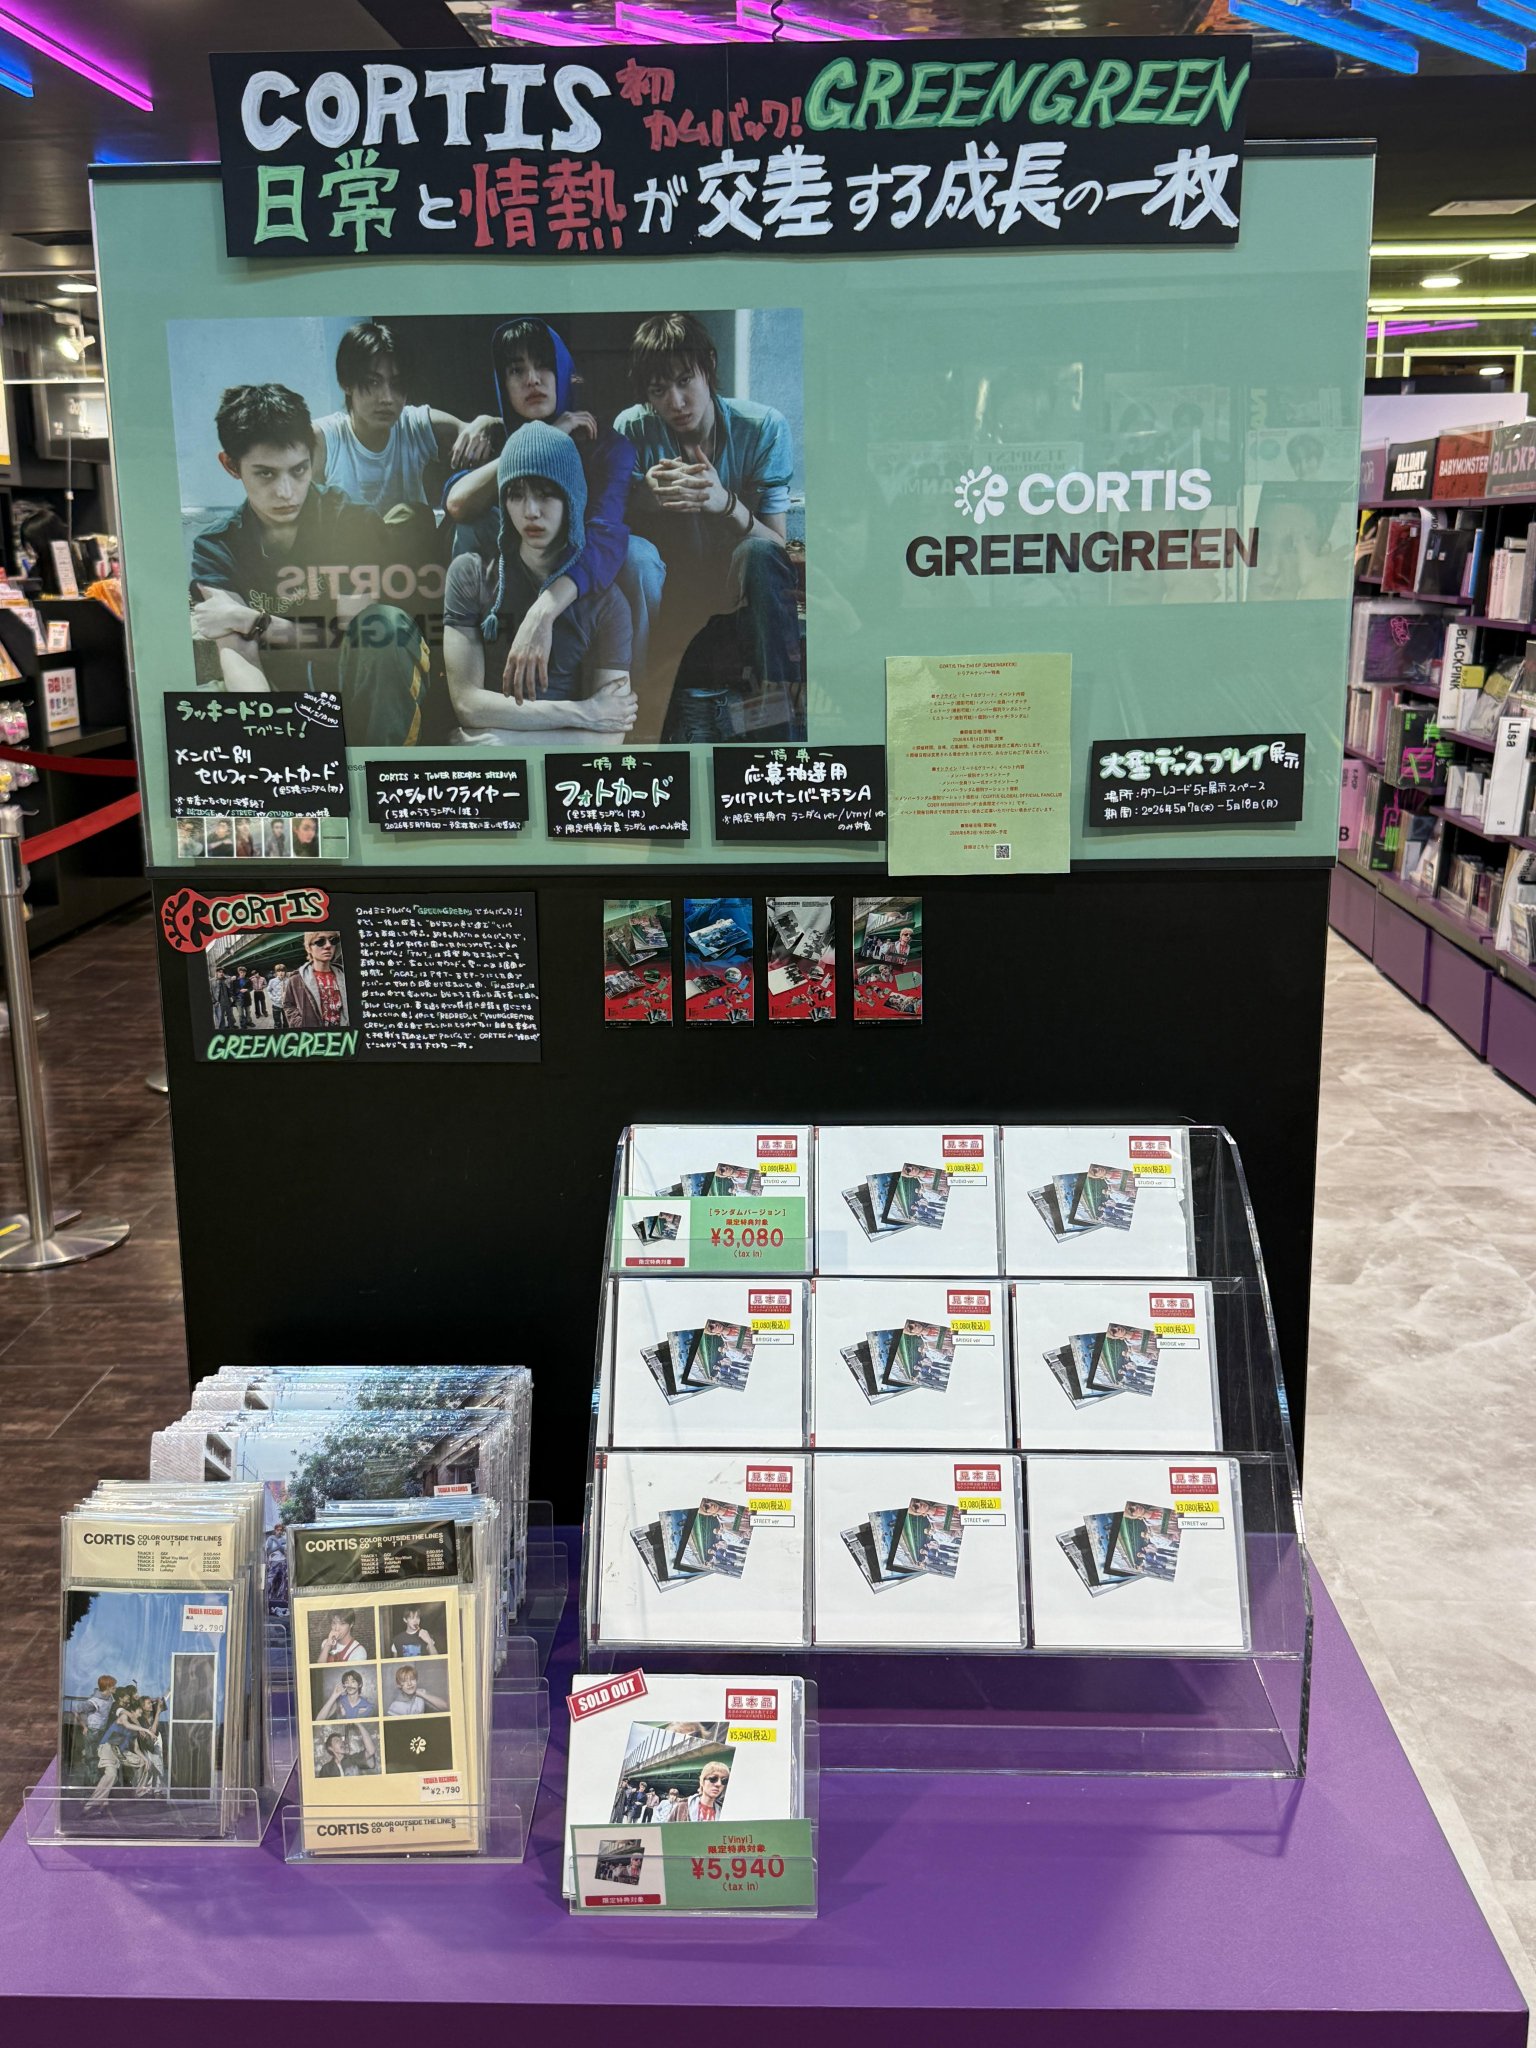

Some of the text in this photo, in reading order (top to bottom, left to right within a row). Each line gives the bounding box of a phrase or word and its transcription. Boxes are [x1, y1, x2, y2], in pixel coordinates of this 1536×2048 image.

[805, 56, 1250, 131] GREENGREEN
[241, 62, 611, 152] CORTIS
[1395, 451, 1428, 472] ALLDAY
[1439, 456, 1489, 477] BABYMONSTER
[1391, 470, 1427, 492] PROJECT
[1018, 468, 1212, 516] CORTIS
[905, 527, 1260, 578] GREENGREEN
[1449, 629, 1467, 690] BLACKPINK
[1507, 723, 1521, 748] Lisa
[379, 773, 409, 782] CORTIS
[425, 772, 450, 781] TOWER
[744, 761, 848, 786] 応募抽選用
[555, 775, 674, 808] フォトカード
[211, 891, 324, 931] CORTIS
[207, 1030, 359, 1061] GREENGREEN
[760, 1139, 794, 1150] 見本品
[946, 1139, 981, 1149] 見本品
[1134, 1141, 1168, 1150] 見本品
[725, 1218, 769, 1227] 限定特典対象
[710, 1227, 784, 1249] ¥3,080
[753, 1294, 788, 1305] 見本品
[952, 1294, 988, 1305] 見本品
[1155, 1298, 1191, 1308] 見本品
[749, 1470, 789, 1483] 見本品
[958, 1470, 997, 1482] 見本品
[1173, 1472, 1212, 1484] 見本品
[84, 1533, 136, 1546] CORTIS
[305, 1538, 358, 1552] CORTIS
[383, 1535, 410, 1543] OUTSIDE
[411, 1533, 423, 1541] THE
[424, 1532, 443, 1540] LINES
[203, 1608, 223, 1616] RECORDS
[578, 1678, 636, 1712] SOLD OUT
[731, 1696, 773, 1709] 見本品
[438, 1776, 458, 1784] RECORDS
[317, 1822, 369, 1836] CORTIS
[708, 1844, 766, 1854] 限定特典対象
[692, 1854, 785, 1880] ¥5,940
[722, 1881, 759, 1891] (tax in)
